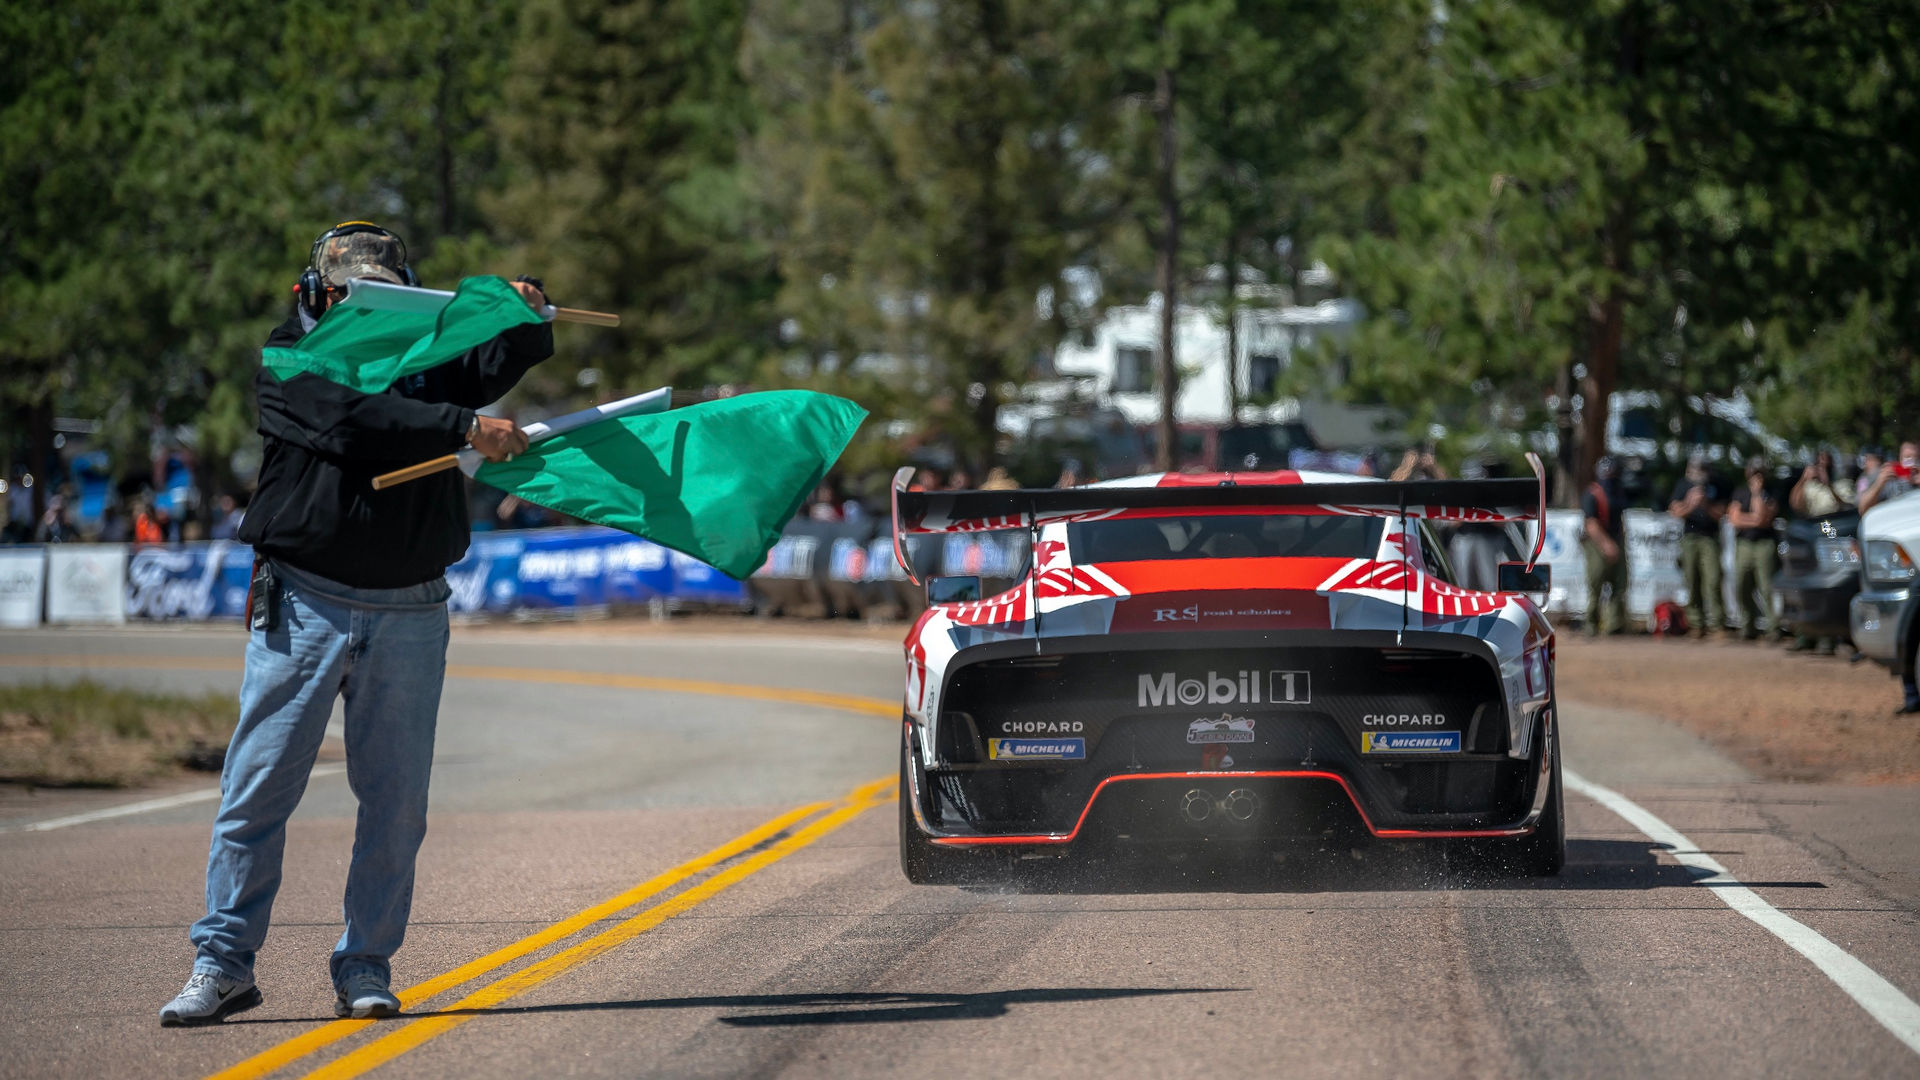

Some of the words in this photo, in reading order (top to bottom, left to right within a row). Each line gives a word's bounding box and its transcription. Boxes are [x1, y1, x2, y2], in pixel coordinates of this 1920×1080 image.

[1203, 608, 1233, 616] road
[1237, 608, 1292, 616] scholars
[1138, 671, 1260, 707] Mobil
[1363, 714, 1446, 726] CHOPARD
[1002, 721, 1084, 733] CHOPARD
[1391, 737, 1453, 748] MICHELIN
[1015, 744, 1077, 755] MICHELIN
